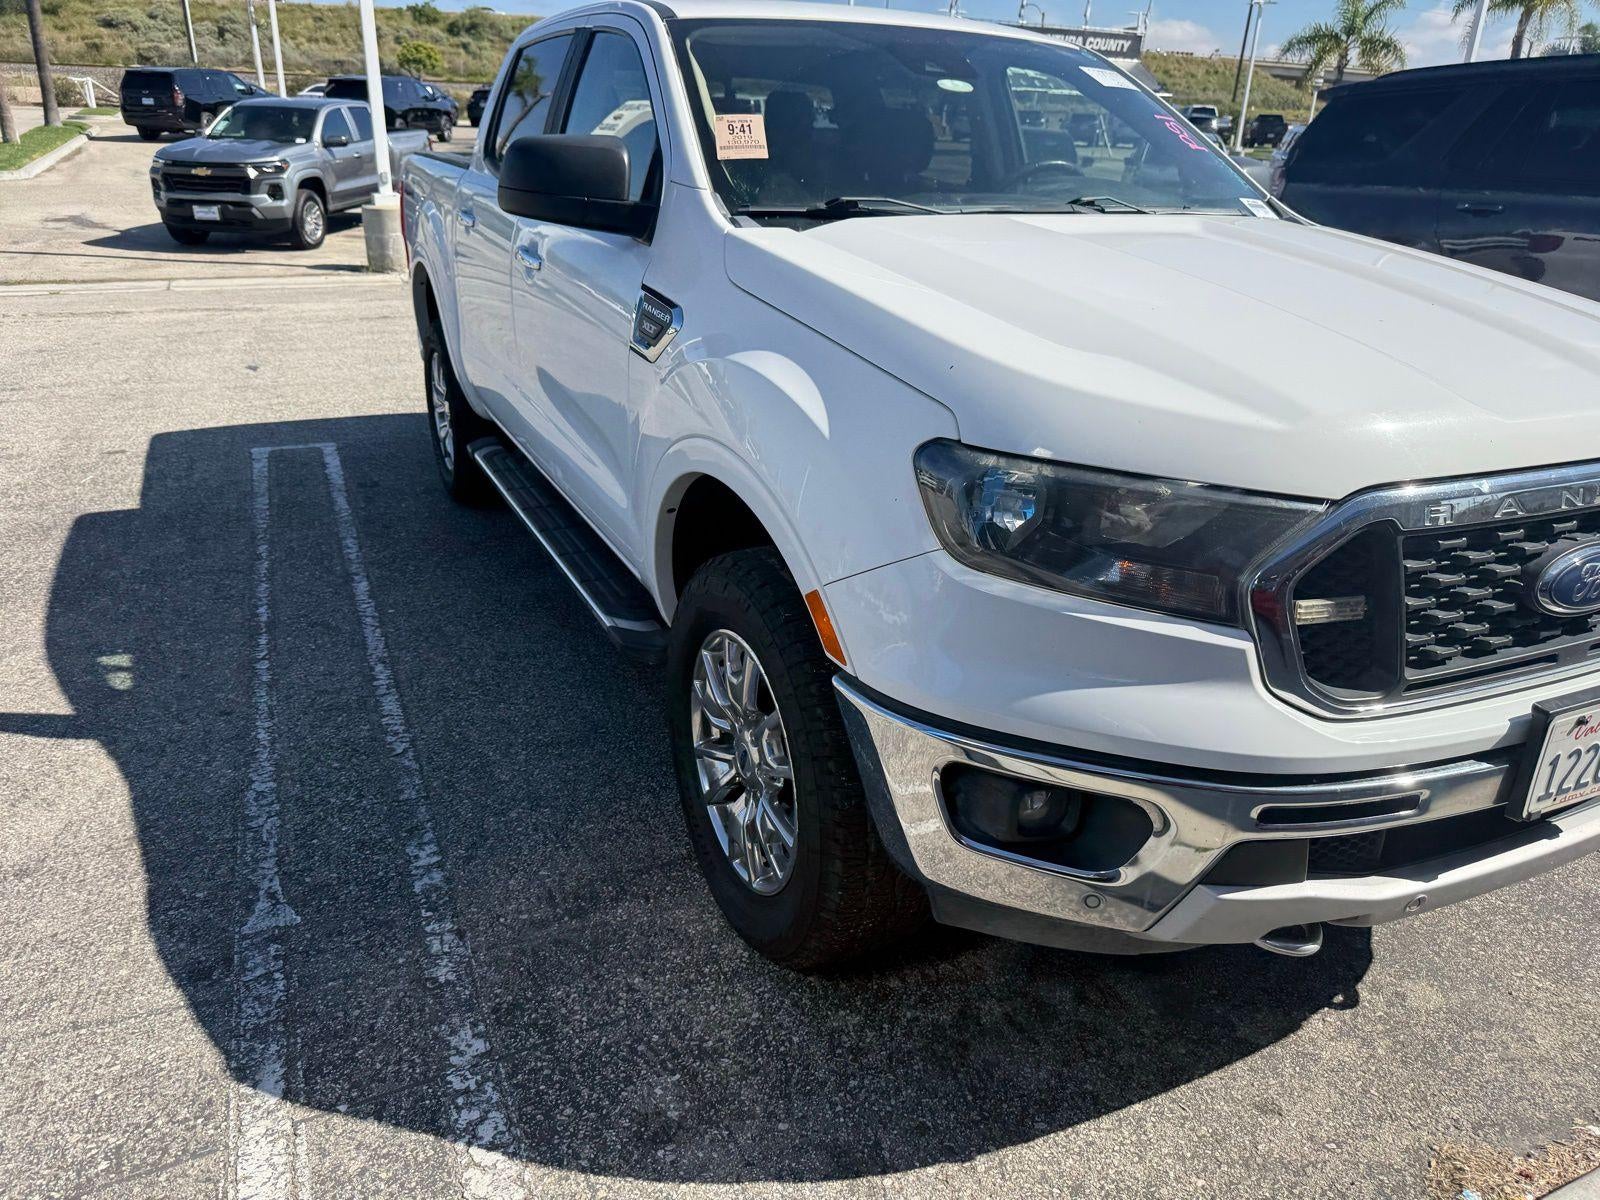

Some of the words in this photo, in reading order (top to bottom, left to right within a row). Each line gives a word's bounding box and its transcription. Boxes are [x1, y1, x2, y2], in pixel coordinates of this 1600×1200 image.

[1085, 37, 1132, 52] COUNTY
[727, 123, 752, 135] 9:41
[642, 302, 671, 323] RANGER
[641, 319, 657, 334] XLT
[1424, 482, 1600, 526] RAN
